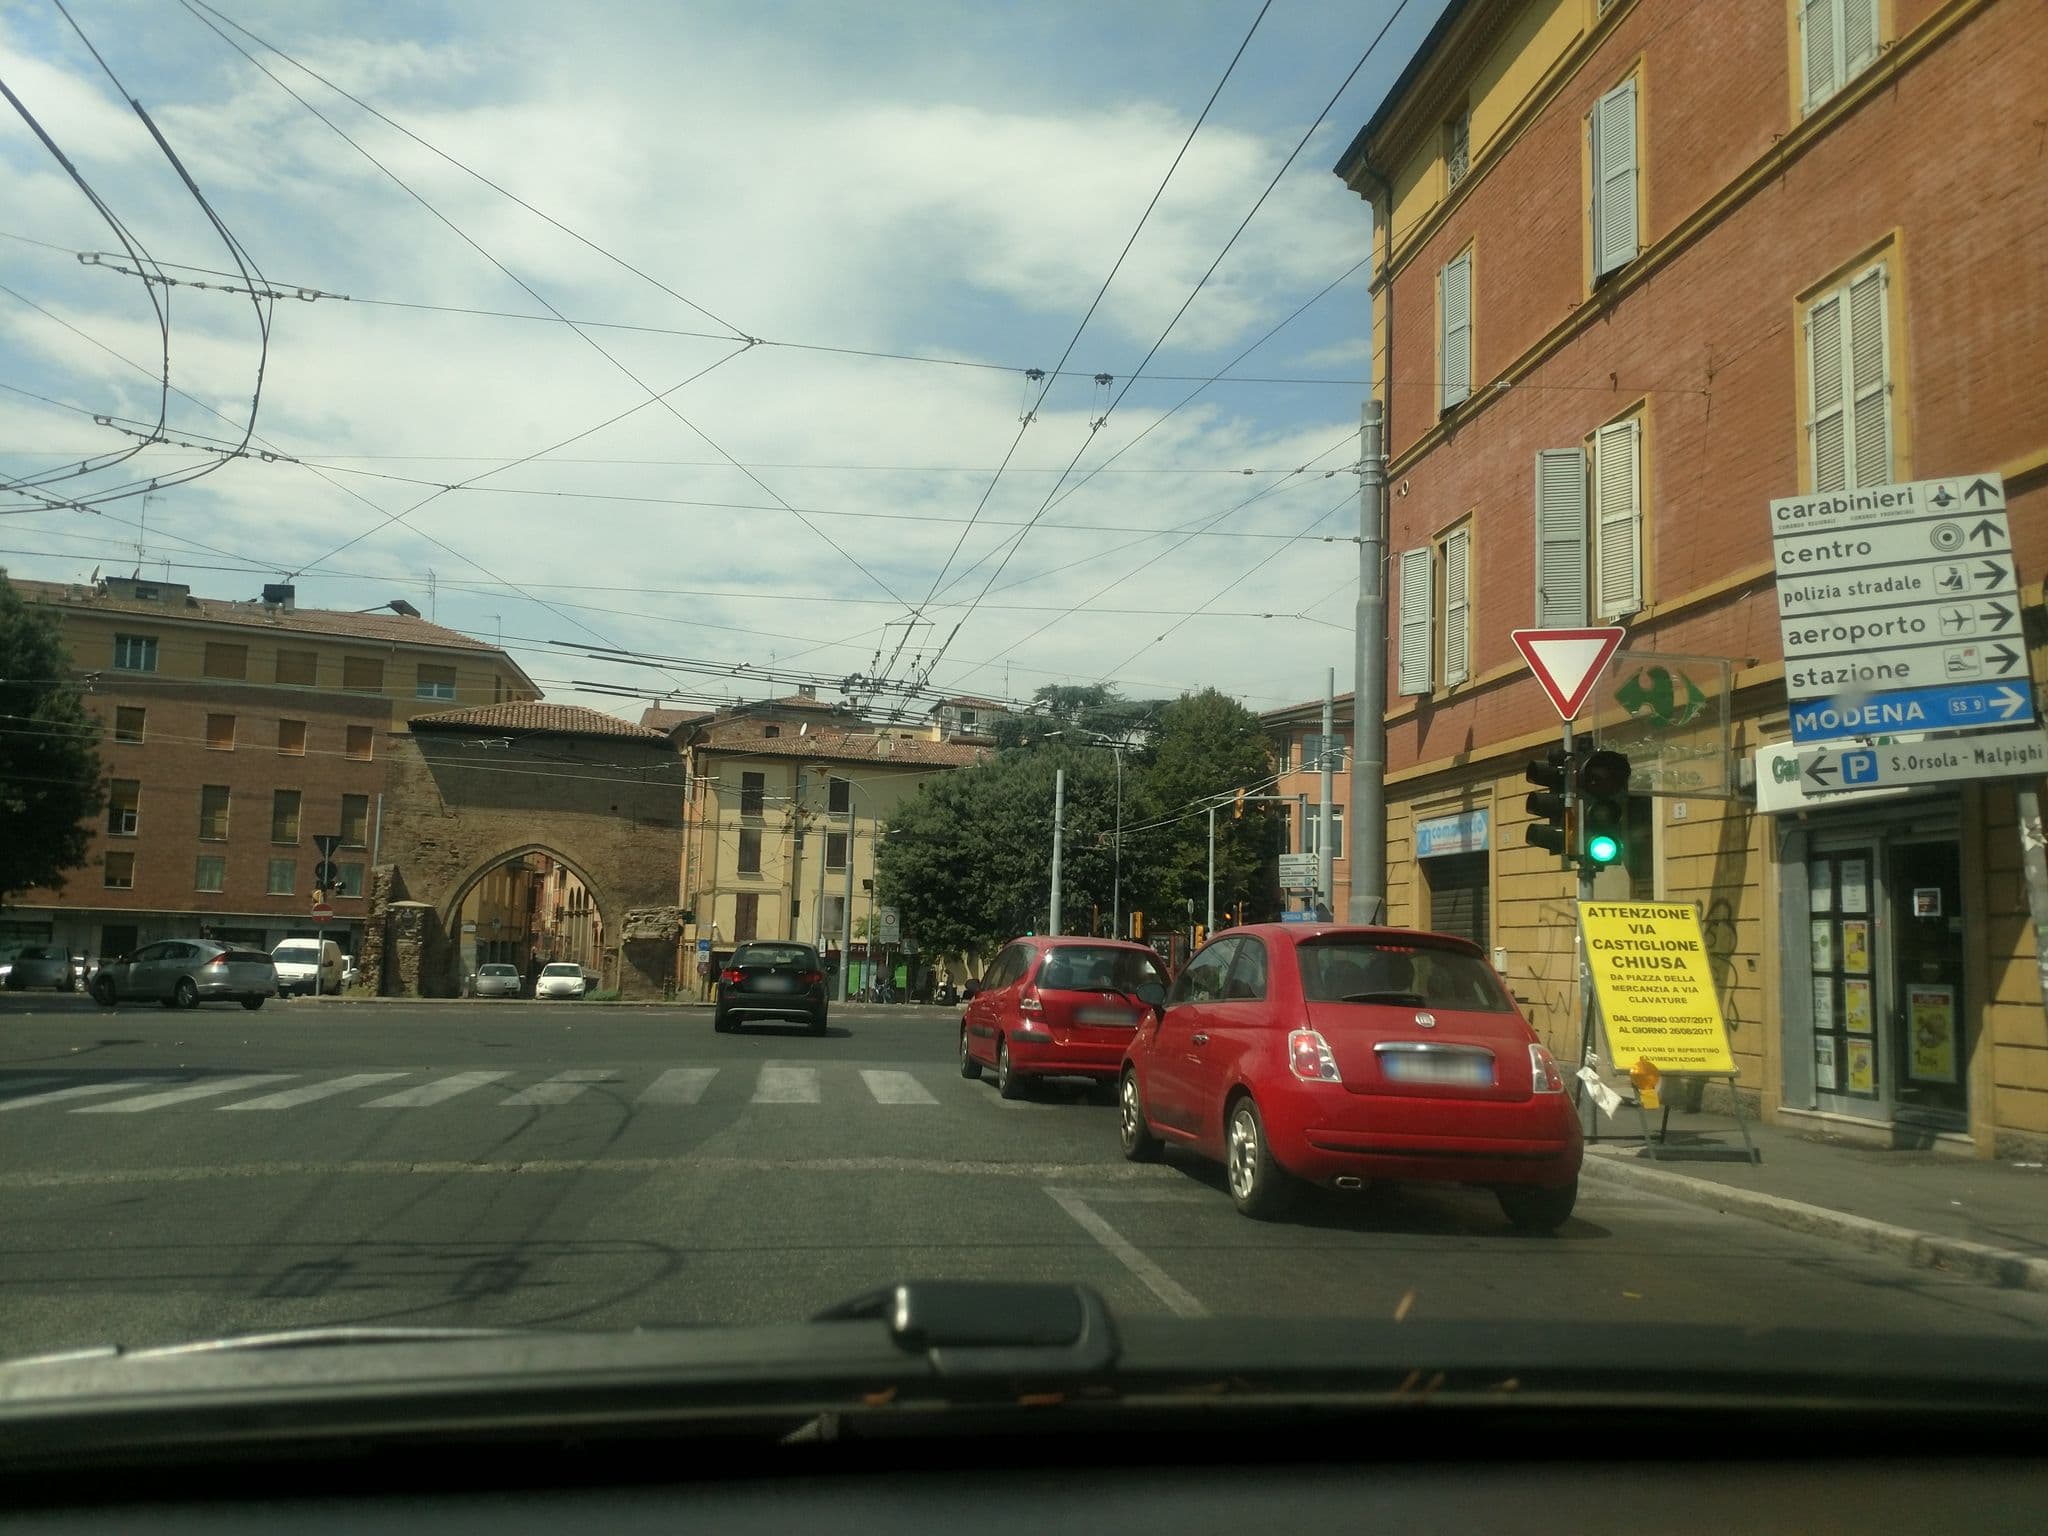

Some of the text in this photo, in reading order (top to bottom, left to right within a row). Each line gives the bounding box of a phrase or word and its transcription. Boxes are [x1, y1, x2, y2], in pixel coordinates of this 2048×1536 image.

[1776, 487, 1914, 520] carabinieri
[1781, 541, 1872, 564] centro
[1784, 576, 1921, 607] polizia stradale
[1788, 616, 1925, 644] aeroporto
[1792, 663, 1910, 687] stazione
[1952, 699, 1982, 712] SS 9
[1796, 701, 1925, 732] MODENA
[1974, 744, 2043, 766] Malpighi
[1850, 756, 1870, 779] P
[1588, 907, 1690, 920] ATTENZIONE
[1628, 924, 1656, 935] VIA
[1592, 939, 1699, 951] CASTIGLIONE
[1612, 956, 1687, 969] CHIUSA
[1626, 974, 1662, 982] PIAZZA
[1612, 985, 1669, 993] MERCANZIA
[1628, 996, 1688, 1004] CLAVATURE
[1619, 1026, 1631, 1034] AL
